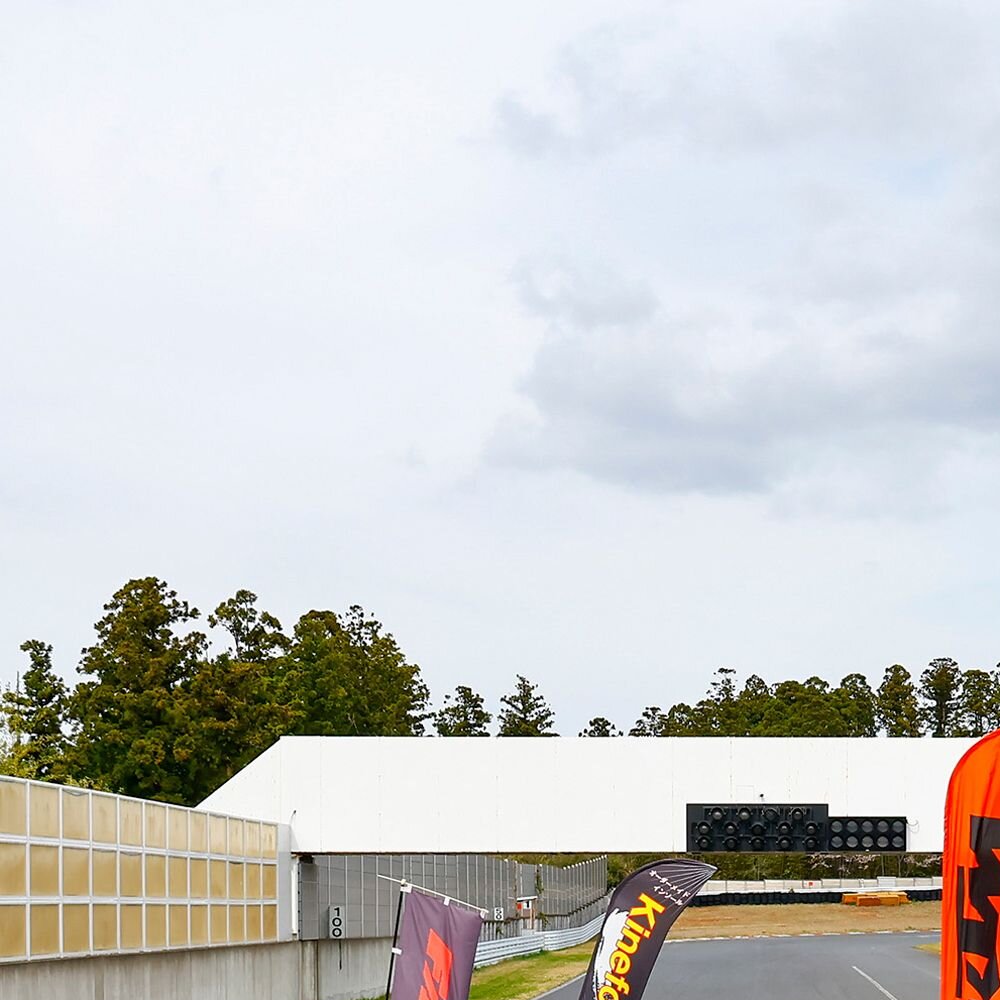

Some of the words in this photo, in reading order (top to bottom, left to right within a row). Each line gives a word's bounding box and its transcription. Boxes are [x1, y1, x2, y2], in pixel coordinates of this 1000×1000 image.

[653, 885, 683, 906] インソール
[331, 906, 343, 938] 100
